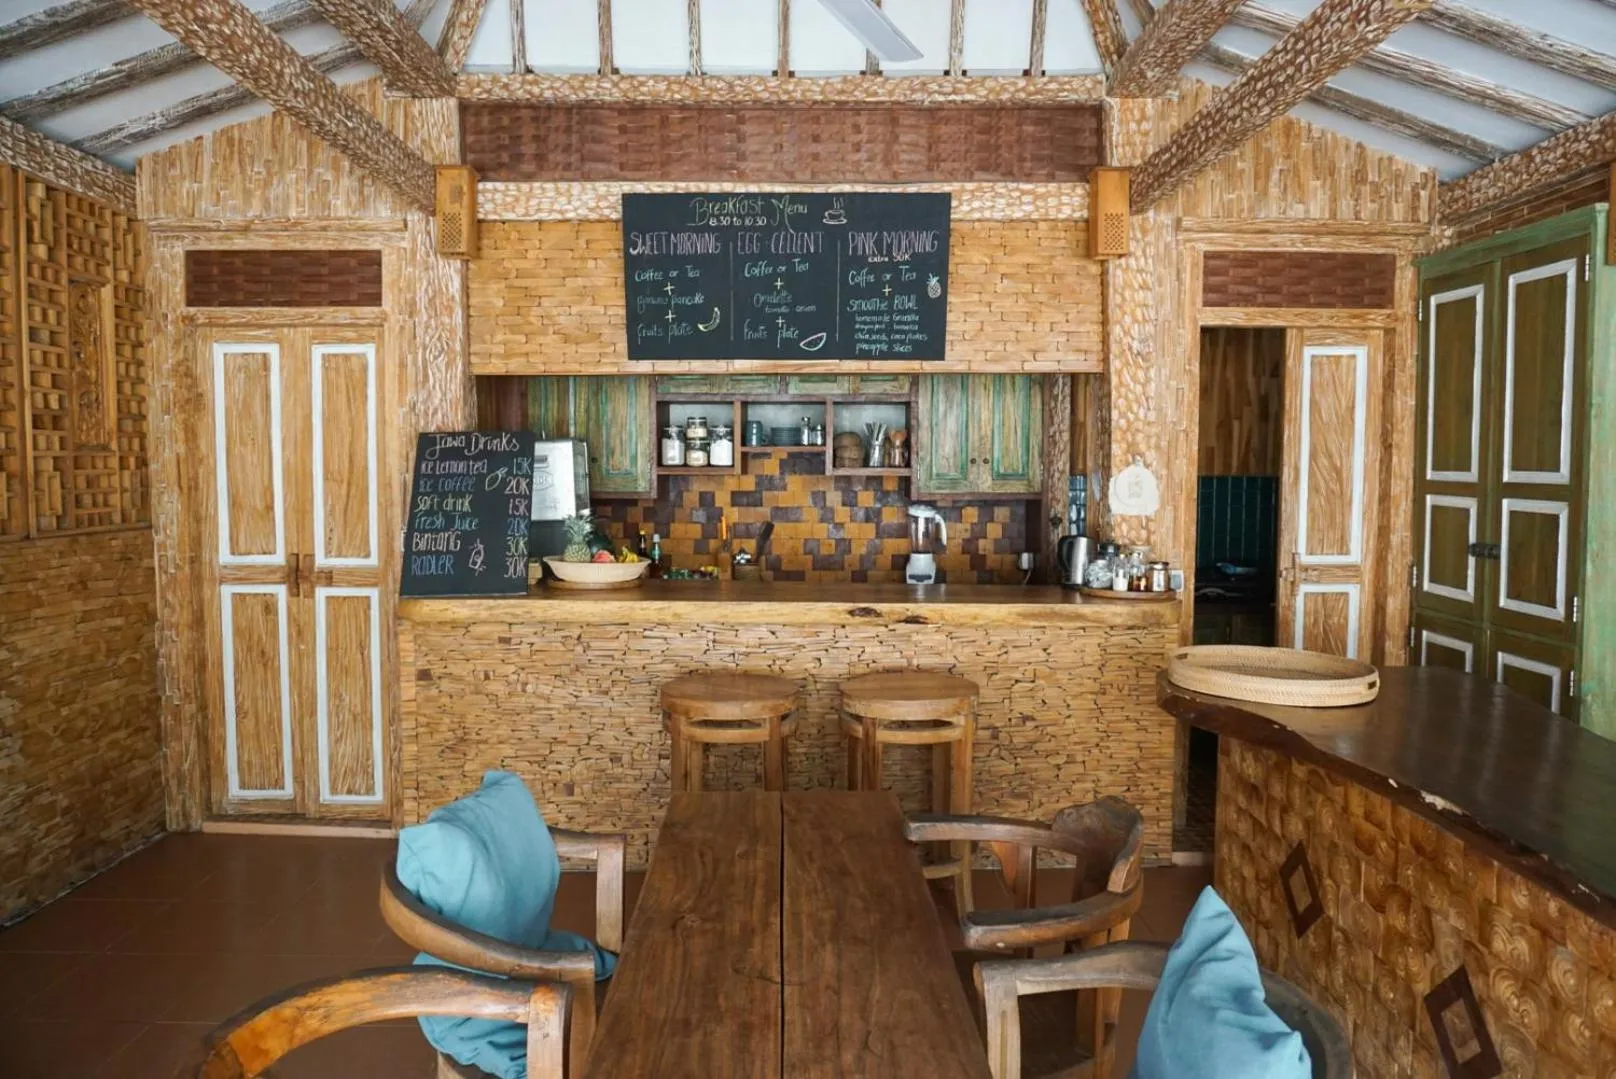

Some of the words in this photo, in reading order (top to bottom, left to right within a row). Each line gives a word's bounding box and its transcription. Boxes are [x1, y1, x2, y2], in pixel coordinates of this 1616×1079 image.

[733, 215, 742, 225] to
[770, 194, 808, 234] Menu
[629, 231, 669, 255] SWEET
[634, 268, 664, 282] Coffee
[668, 270, 679, 278] or
[685, 264, 700, 278] Tea
[744, 260, 774, 278] Coffee
[777, 265, 787, 273] or
[792, 258, 809, 273] Tea
[848, 267, 876, 289] Coffee
[881, 272, 893, 282] or
[898, 265, 917, 283] Tea
[513, 456, 532, 476] 15K
[504, 475, 530, 496] 20K
[508, 498, 530, 517] 15K
[504, 536, 529, 557] 30K
[503, 556, 529, 579] 30K
